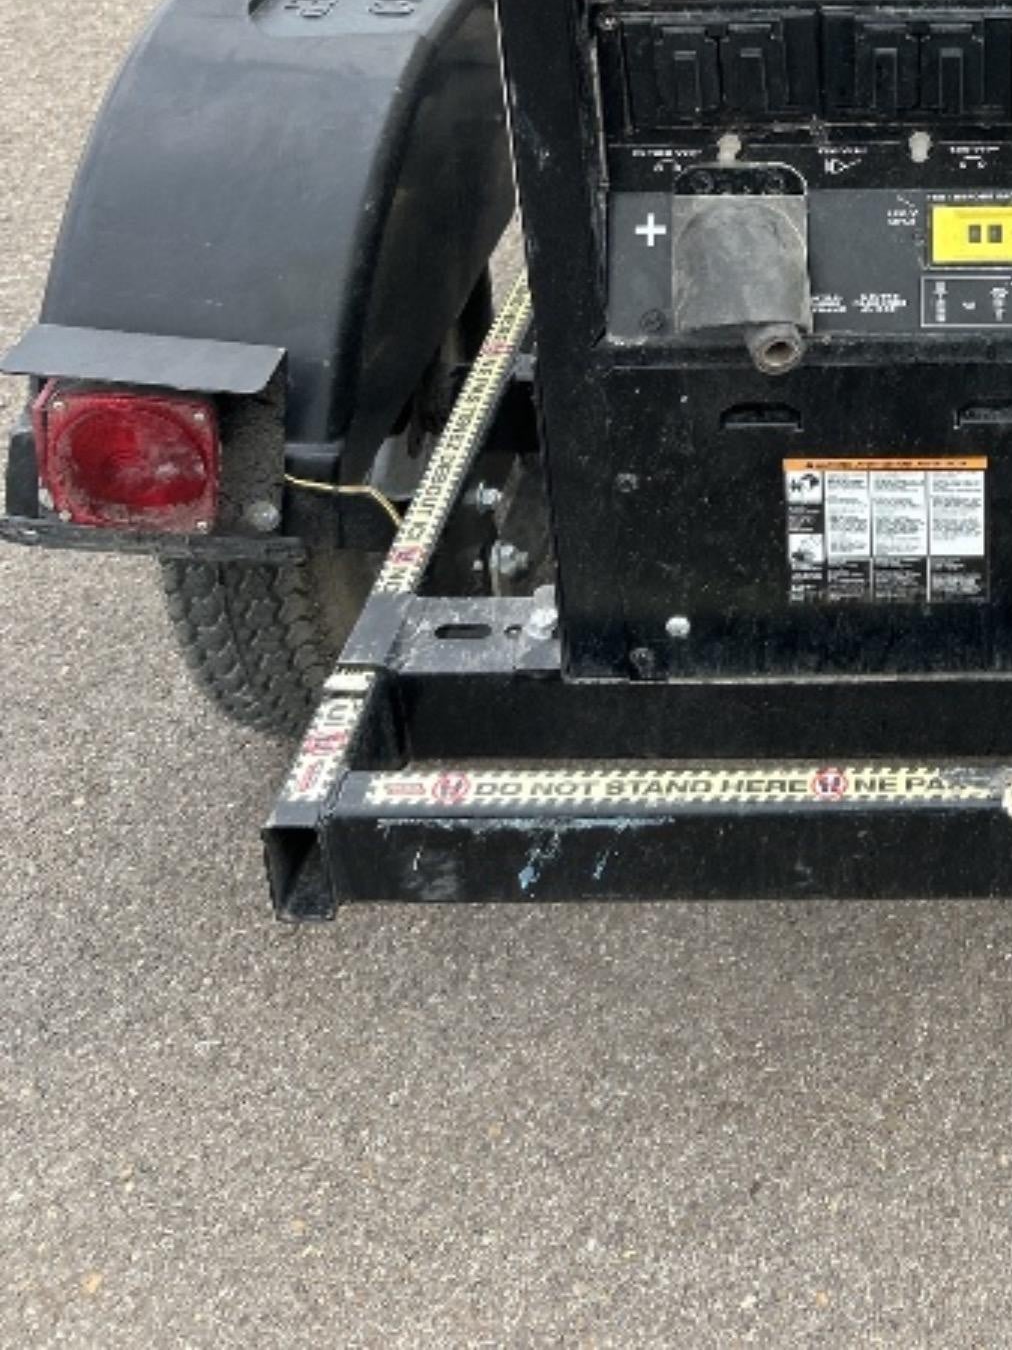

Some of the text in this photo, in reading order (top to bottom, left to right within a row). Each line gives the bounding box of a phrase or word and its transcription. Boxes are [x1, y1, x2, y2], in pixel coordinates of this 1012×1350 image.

[474, 778, 808, 796] DO NOT STAND HERE
[854, 775, 948, 792] NE PA
